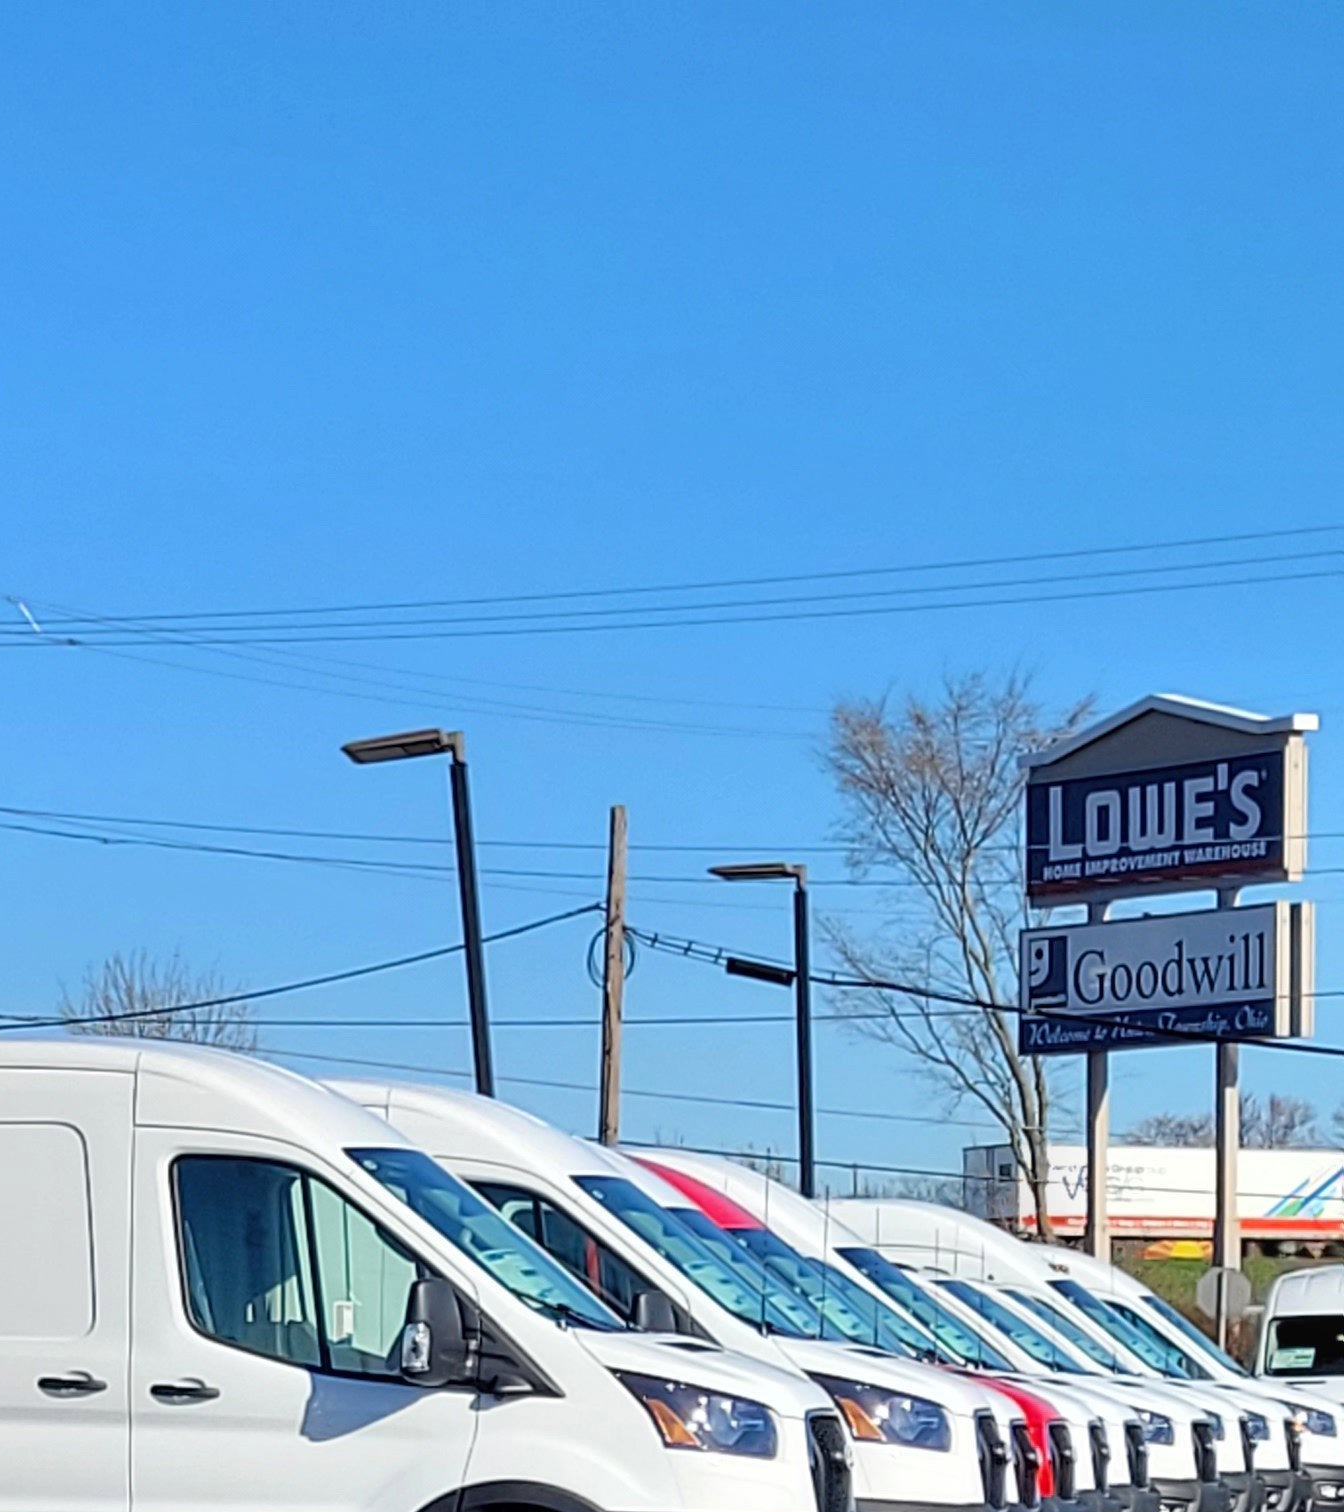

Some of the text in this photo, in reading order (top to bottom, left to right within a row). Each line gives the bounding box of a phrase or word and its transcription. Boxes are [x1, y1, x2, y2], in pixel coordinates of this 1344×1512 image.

[1048, 763, 1261, 862] LOWE'S
[1043, 841, 1267, 881] HOME IMPROVEMENT WAREHOUSE
[1073, 930, 1266, 1004] Goodwill
